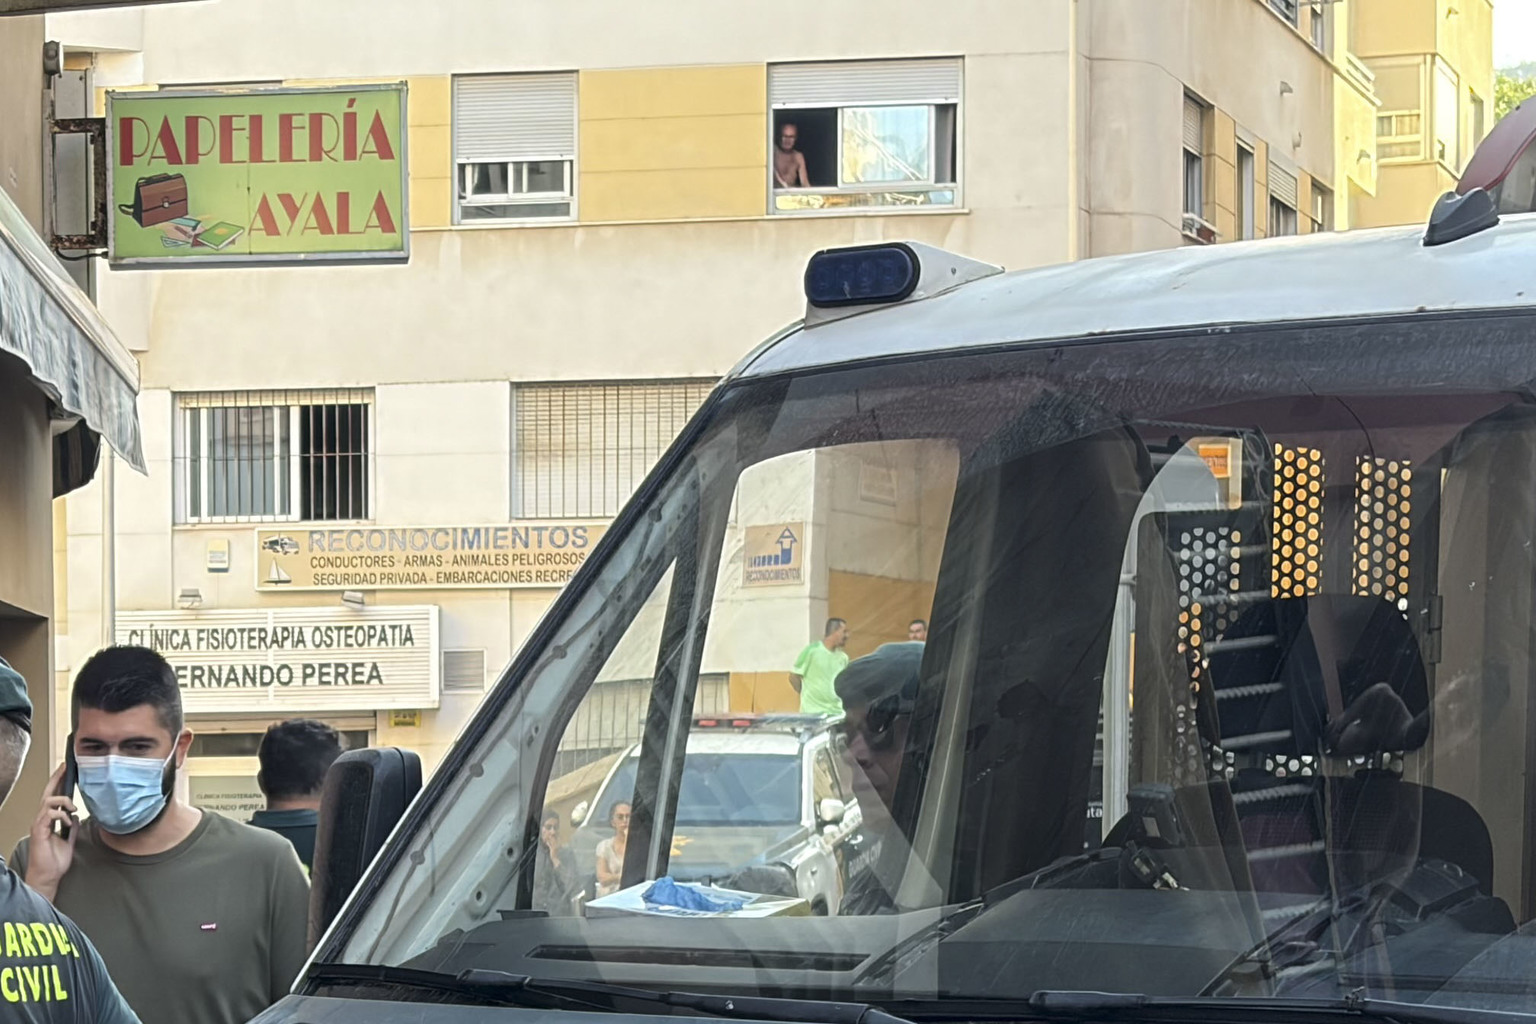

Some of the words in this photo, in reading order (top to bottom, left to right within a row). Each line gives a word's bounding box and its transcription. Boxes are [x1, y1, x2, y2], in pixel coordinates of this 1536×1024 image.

[119, 98, 395, 166] PAPELERÍA
[248, 190, 396, 236] AYALA
[309, 526, 588, 552] RECONOCIMIENTOS
[310, 555, 395, 569] CONDUCTORES
[404, 554, 443, 567] ARMAS
[451, 553, 509, 567] ANIMALES
[512, 552, 586, 566] PELIGROSOS
[313, 573, 377, 586] SEGURIDAD
[379, 572, 428, 585] PRIVADA
[436, 570, 533, 584] EMBARCACIONES
[535, 569, 573, 582] RECRE
[196, 626, 307, 651] FISIOTERAPIA
[311, 624, 415, 649] OSTEOPATIA
[175, 664, 294, 688] ERNANDO
[302, 662, 384, 686] PEREA
[0, 964, 68, 1003] CIVIL
